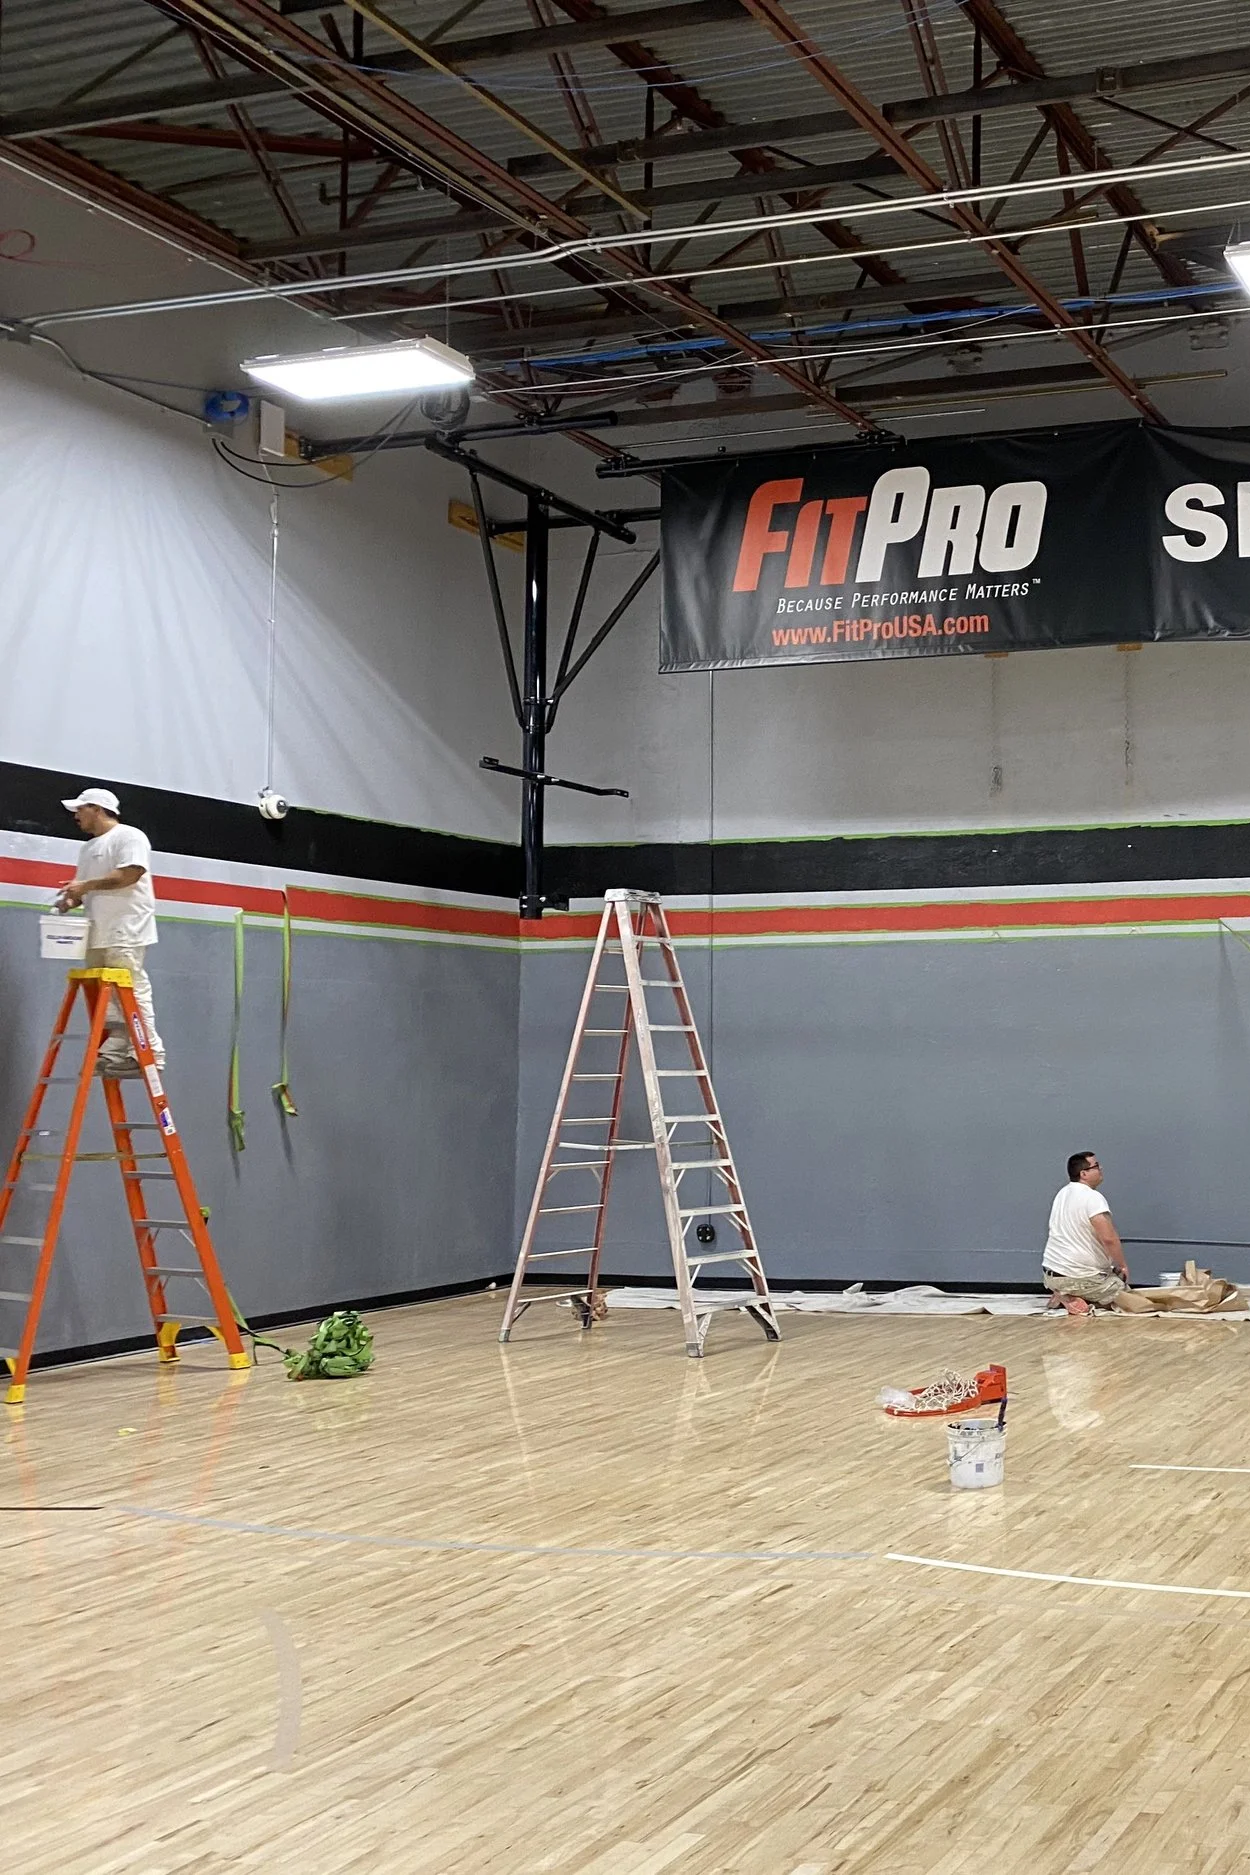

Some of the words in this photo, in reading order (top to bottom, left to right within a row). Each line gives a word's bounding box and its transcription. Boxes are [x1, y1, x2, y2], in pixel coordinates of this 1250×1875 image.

[733, 466, 1047, 592] FITPRO
[776, 596, 844, 614] BECAUSE
[852, 588, 958, 609] PERFORMANCE
[772, 613, 990, 647] www.FitProUSA.com
